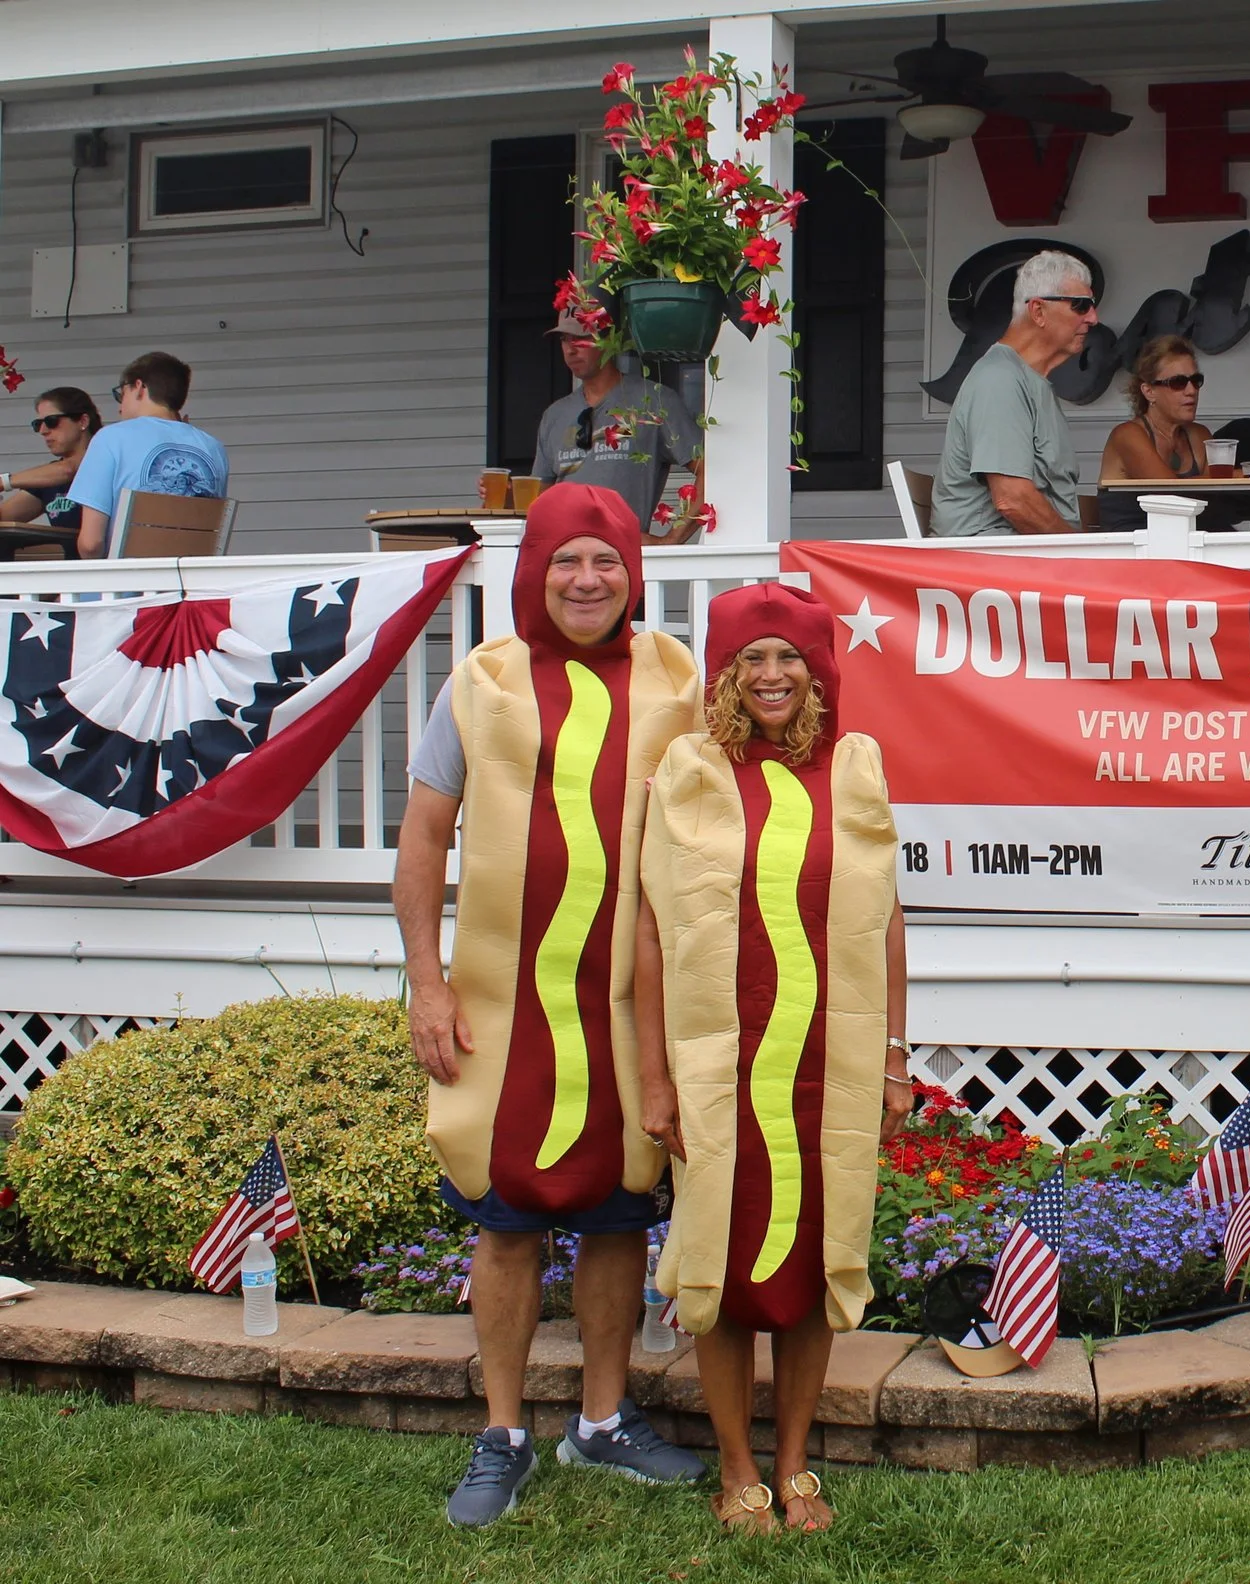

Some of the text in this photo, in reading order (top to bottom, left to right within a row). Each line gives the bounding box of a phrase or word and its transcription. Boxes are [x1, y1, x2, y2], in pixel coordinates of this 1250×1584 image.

[915, 587, 1224, 680] DOLLAR
[1077, 710, 1150, 740] VFW
[1161, 711, 1248, 740] POST
[1095, 752, 1151, 782] ALL
[1162, 752, 1226, 782] ARE
[902, 842, 929, 872] 18
